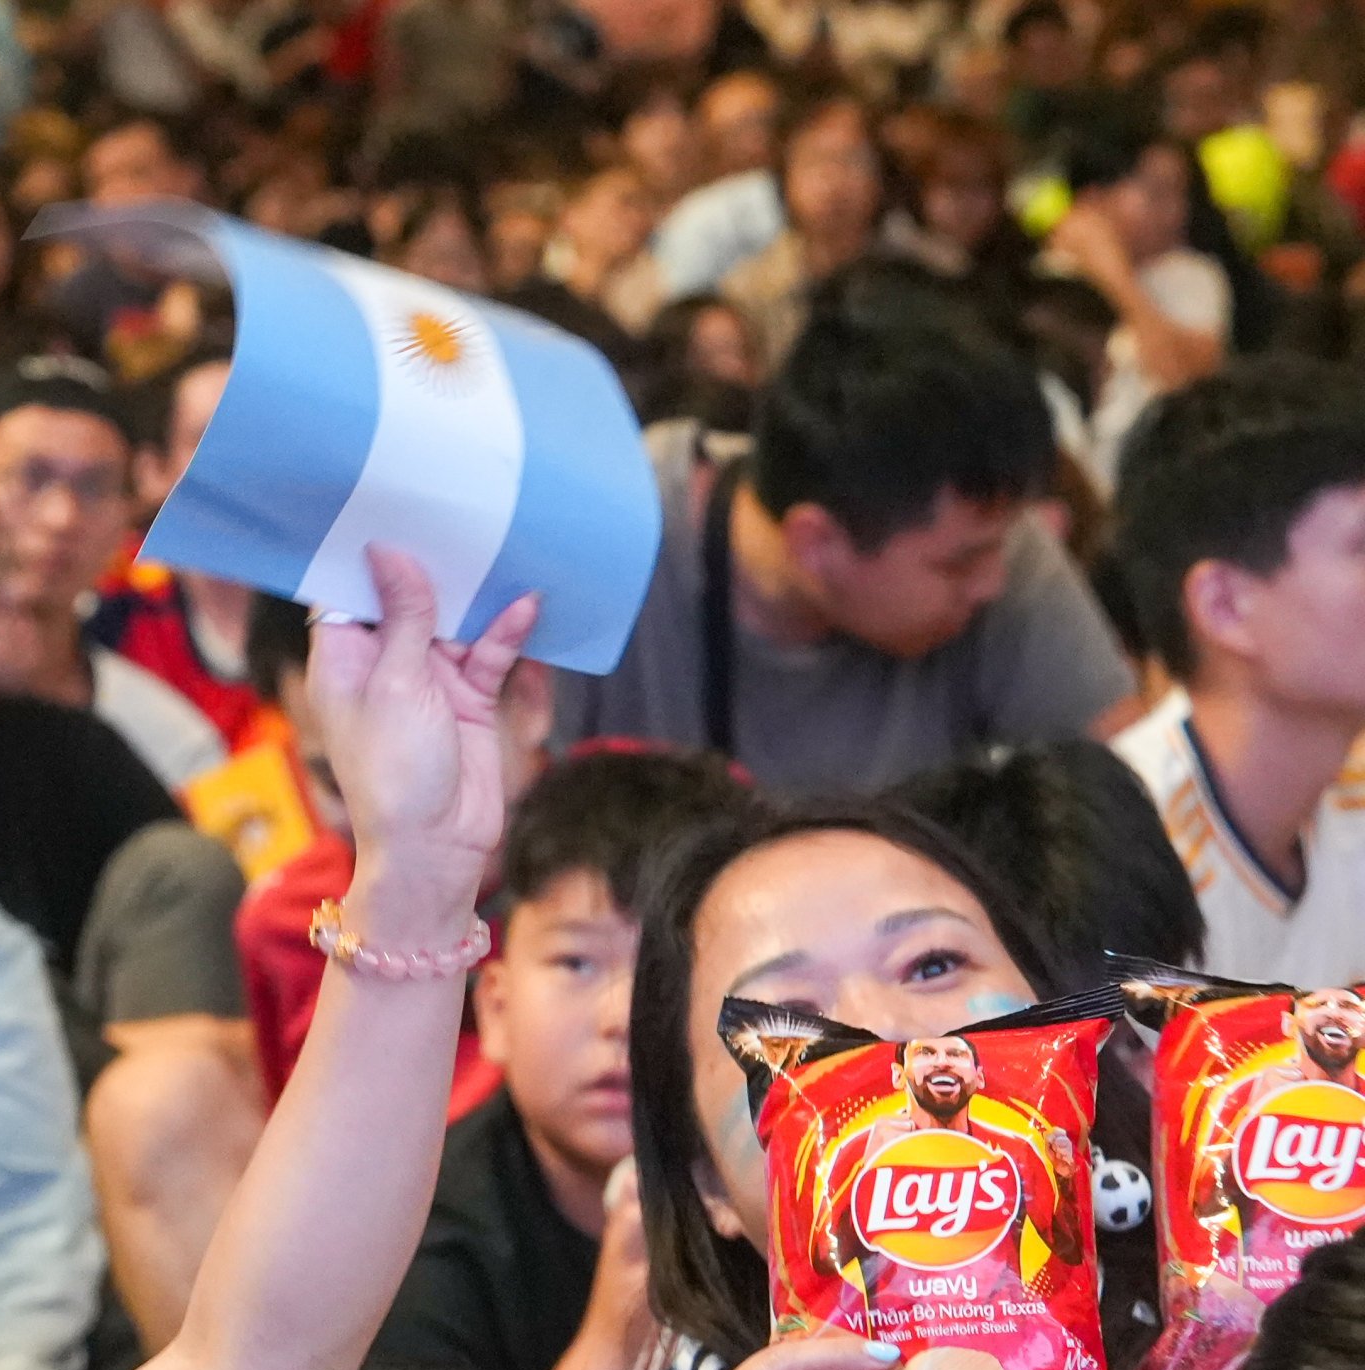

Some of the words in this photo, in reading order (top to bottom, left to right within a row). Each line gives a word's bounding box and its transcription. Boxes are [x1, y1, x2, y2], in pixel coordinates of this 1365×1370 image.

[1245, 1115, 1365, 1192] Lay
[867, 1160, 1009, 1238] Lay's
[909, 1275, 977, 1298] wavy
[845, 1312, 864, 1332] Vị
[913, 1303, 936, 1322] Bò
[1000, 1299, 1047, 1316] Texas
[877, 1328, 912, 1344] Texas
[916, 1322, 979, 1339] Tenderloin
[981, 1320, 1018, 1335] Steak
